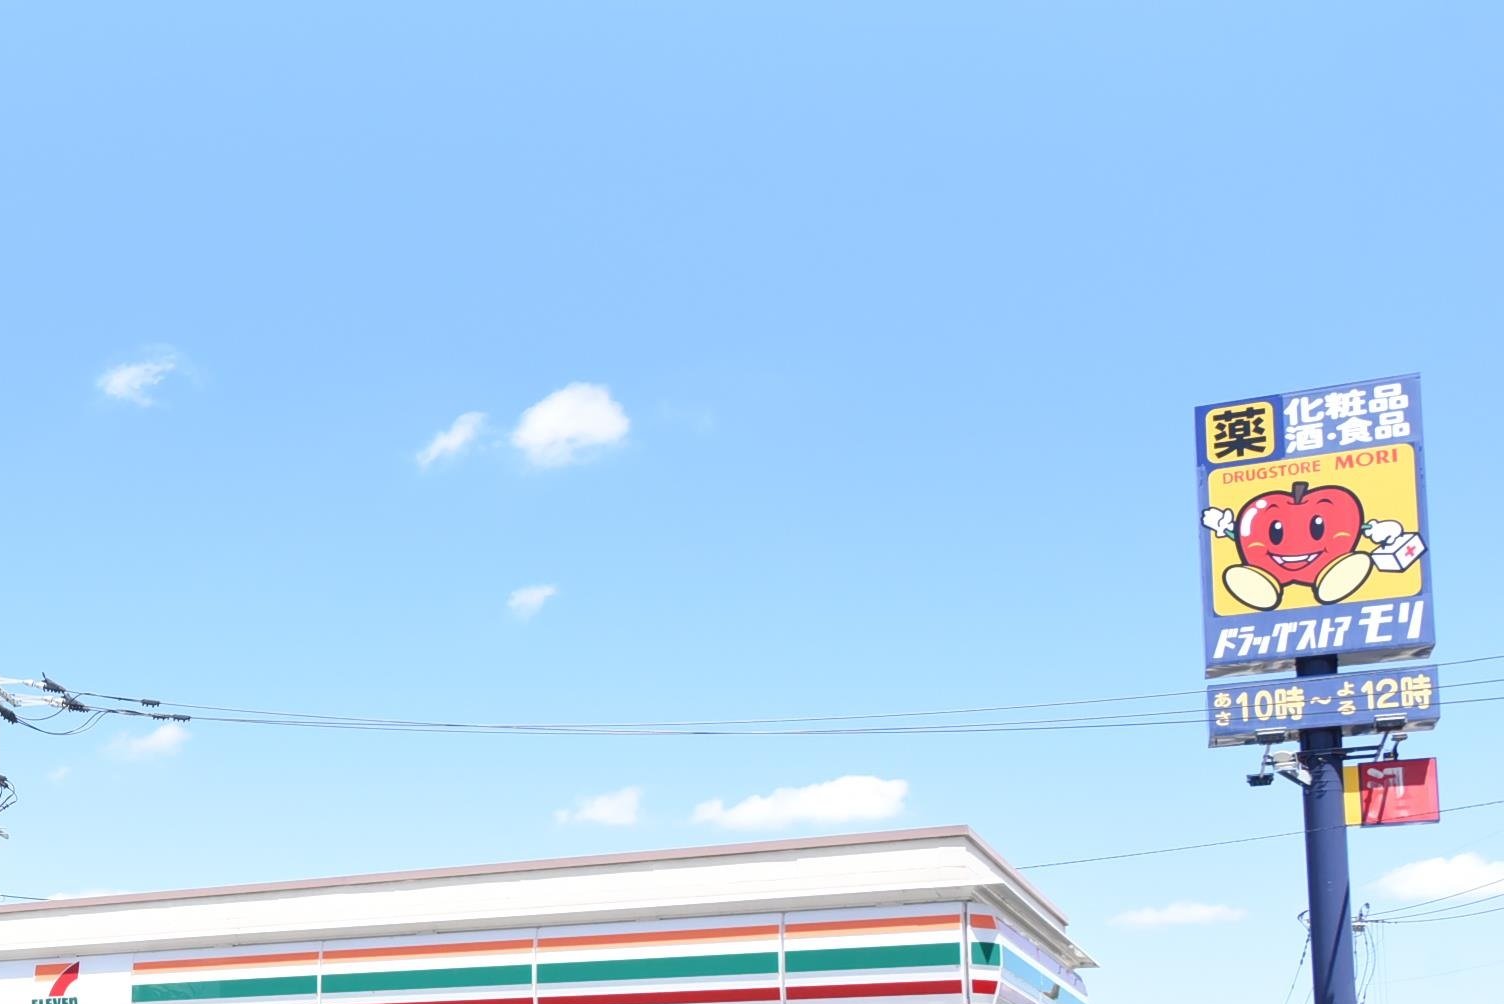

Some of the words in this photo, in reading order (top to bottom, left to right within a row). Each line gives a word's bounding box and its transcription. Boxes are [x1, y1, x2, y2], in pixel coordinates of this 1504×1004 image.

[1284, 383, 1408, 425] 化粧品
[1213, 407, 1266, 459] 薬
[1286, 411, 1410, 454] 酒・食品
[1222, 460, 1321, 485] DRUGSTORE
[1334, 447, 1398, 470] MORI
[1213, 616, 1350, 660] ドラッグストア
[1358, 601, 1424, 644] モリ
